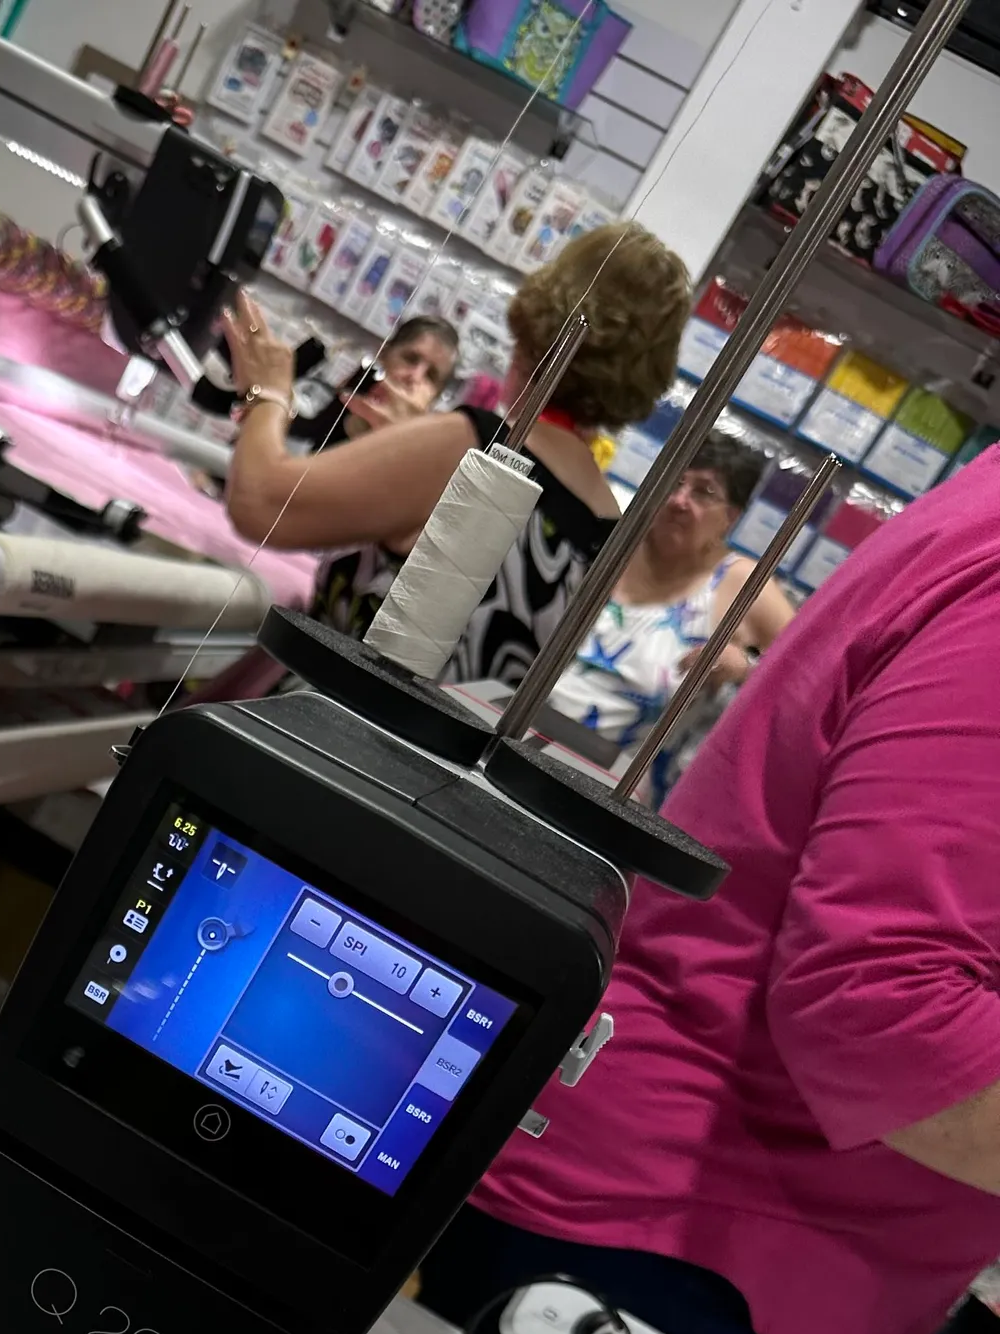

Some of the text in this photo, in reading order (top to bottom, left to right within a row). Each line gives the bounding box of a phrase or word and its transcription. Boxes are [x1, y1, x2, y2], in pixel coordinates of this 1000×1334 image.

[174, 816, 198, 837] 6.25
[135, 899, 152, 915] P1
[343, 936, 408, 979] SPI 10
[87, 984, 107, 1002] BSR
[465, 1008, 494, 1030] BSR1
[435, 1057, 463, 1078] BSR2
[405, 1103, 433, 1124] BSR3
[376, 1151, 401, 1170] MAN
[30, 1267, 78, 1326] Q
